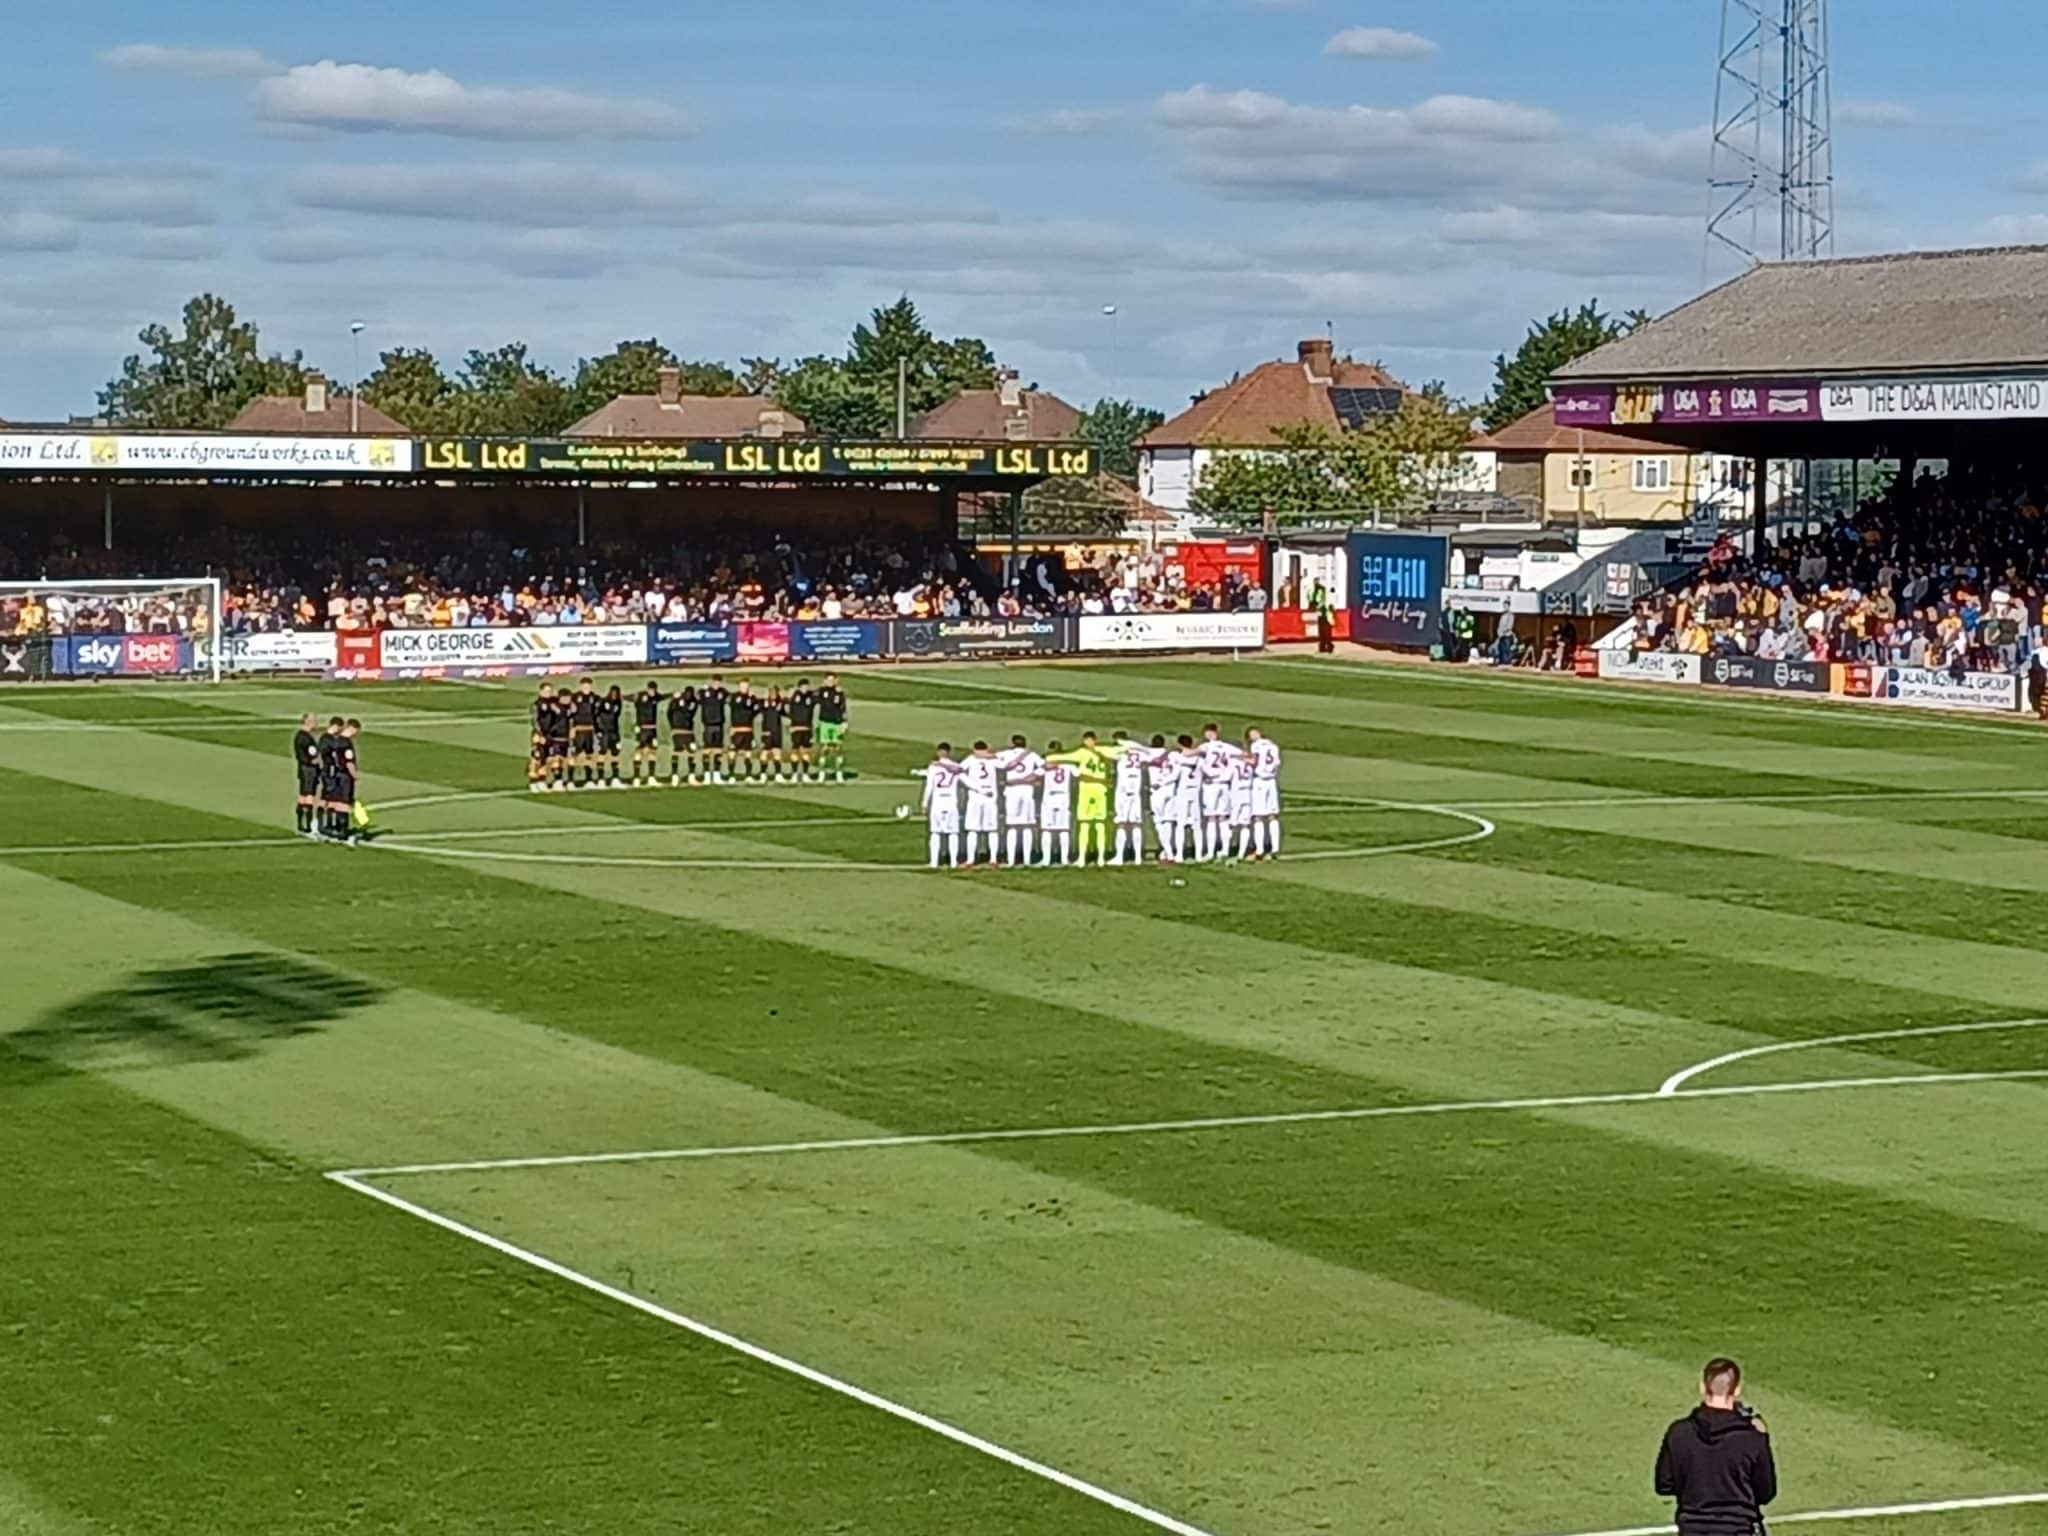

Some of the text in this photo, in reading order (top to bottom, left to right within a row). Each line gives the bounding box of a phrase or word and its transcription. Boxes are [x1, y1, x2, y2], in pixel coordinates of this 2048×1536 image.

[1867, 384, 2041, 413] THE D&A MAINSTAND
[39, 440, 82, 461] Ltd.
[424, 442, 473, 469] LSL
[480, 443, 527, 470] Ltd
[725, 445, 772, 472] LSL
[777, 446, 821, 472] Ltd
[995, 446, 1040, 474] LSL
[1047, 447, 1089, 475] Ltd
[1385, 557, 1427, 599] Hill
[938, 621, 1007, 639] Scaffolding
[1007, 620, 1054, 635] London
[384, 635, 421, 652] MICK
[426, 632, 495, 651] GEORGE
[77, 639, 172, 667] sky bet
[1978, 676, 2011, 690] GROUP
[1211, 751, 1229, 768] 24
[935, 772, 957, 789] 27
[1053, 767, 1065, 784] 8
